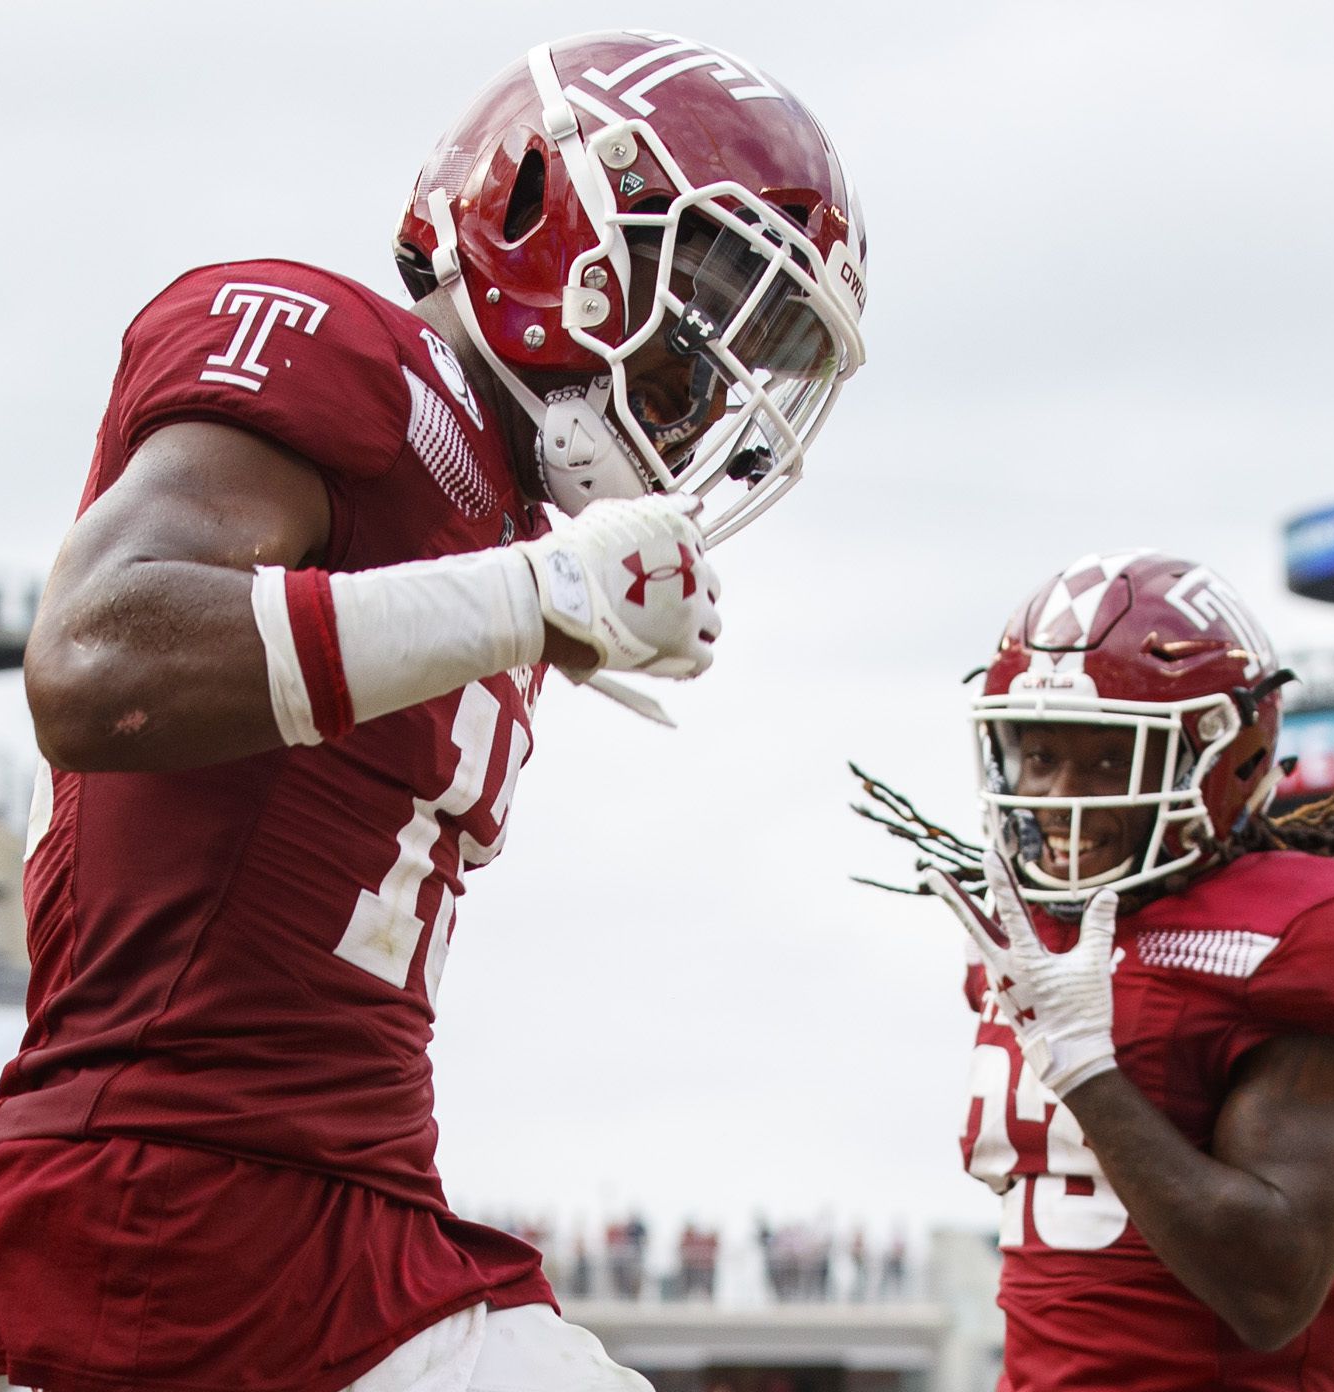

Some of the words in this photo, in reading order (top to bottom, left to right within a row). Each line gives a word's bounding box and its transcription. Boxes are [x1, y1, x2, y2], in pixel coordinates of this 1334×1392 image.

[198, 282, 329, 393] T
[840, 260, 867, 318] OWL
[332, 680, 529, 1022] 1
